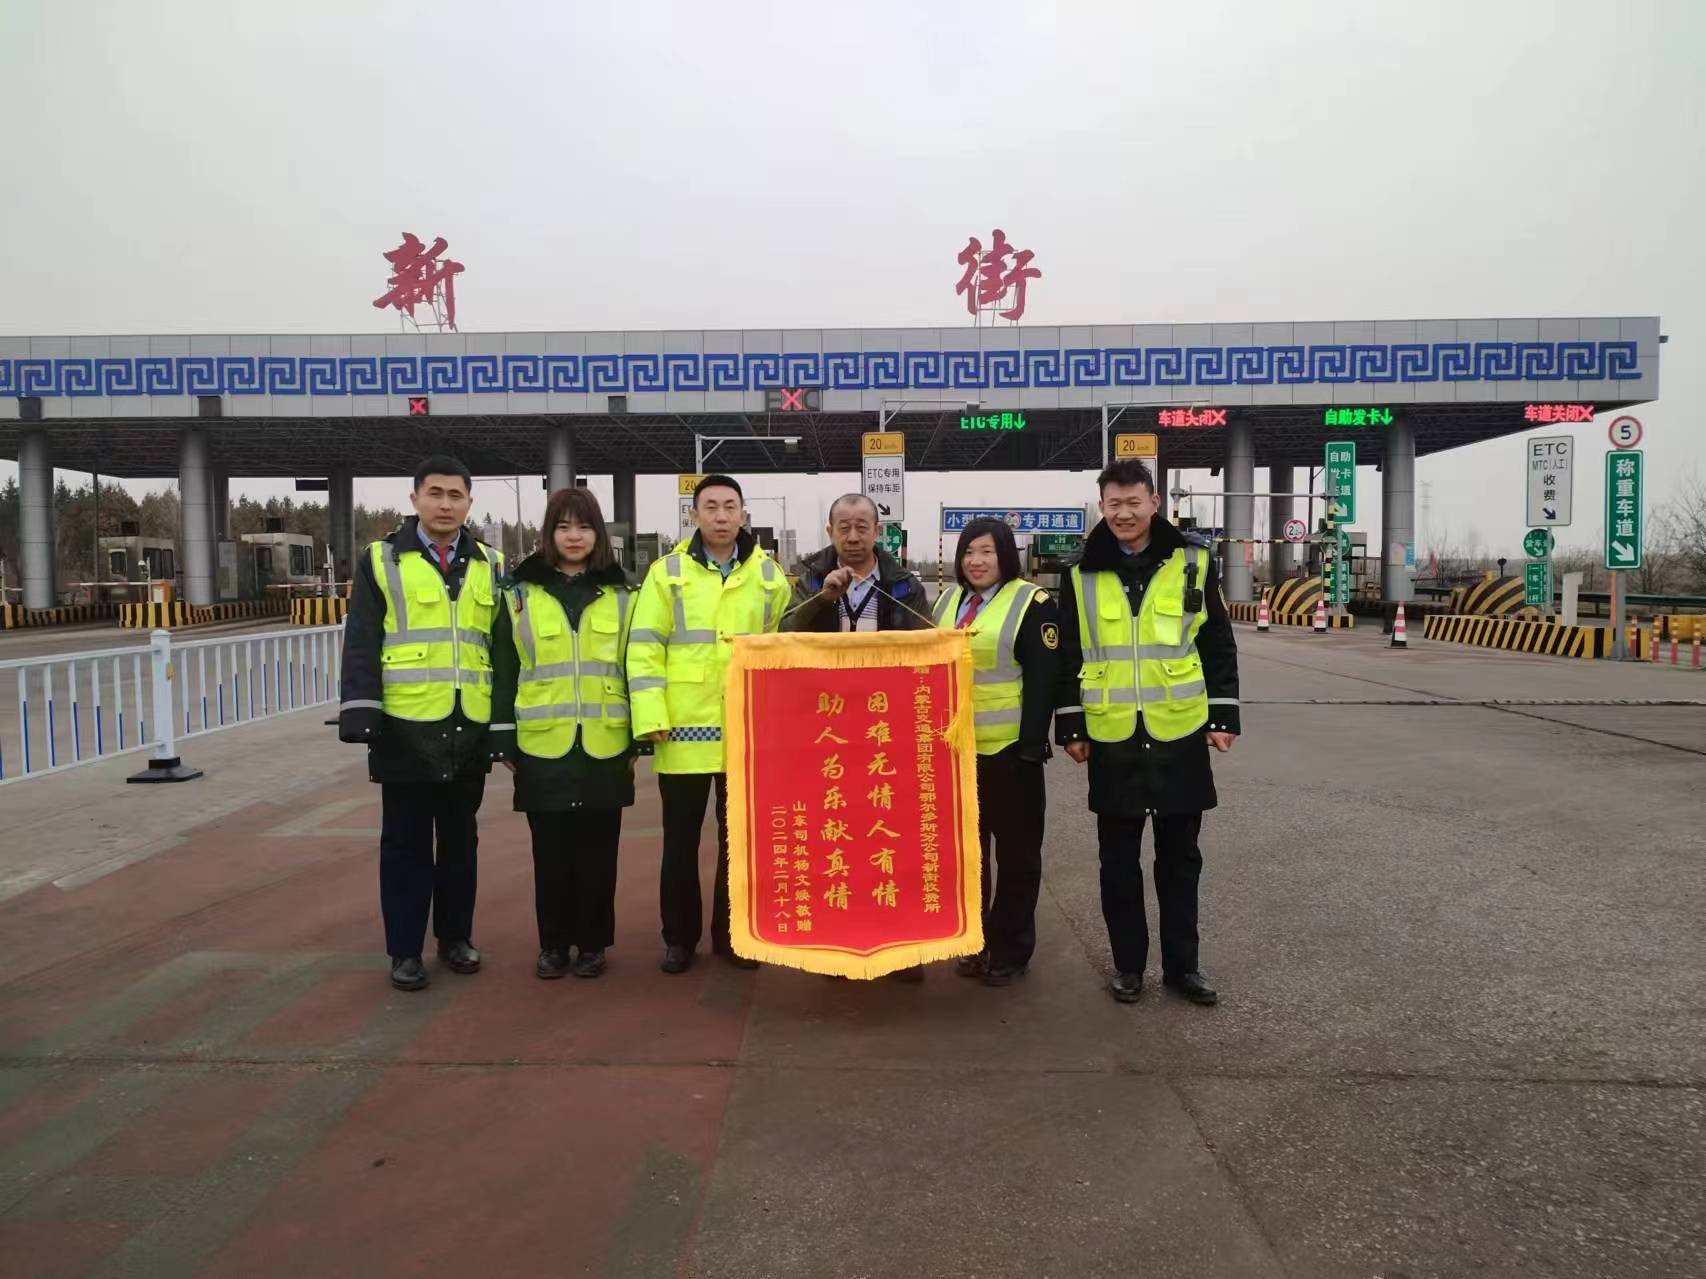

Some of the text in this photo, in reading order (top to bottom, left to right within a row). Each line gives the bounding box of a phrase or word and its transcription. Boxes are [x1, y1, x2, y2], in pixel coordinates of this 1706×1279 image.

[373, 229, 1042, 329] 新 街
[1158, 409, 1212, 427] 车道关闭
[1325, 408, 1380, 426] 自助发卡
[1524, 404, 1580, 422] 车道关闭
[1620, 425, 1632, 440] 5
[870, 438, 882, 450] 20
[1122, 439, 1135, 451] 20
[1533, 442, 1568, 456] ETC
[1330, 451, 1351, 463] 自助
[867, 468, 900, 479] ETC专用
[868, 483, 901, 493] 保持车距
[1543, 474, 1556, 501] 收费
[1615, 458, 1635, 537] 称重车道
[1023, 513, 1078, 528] 专用通道
[814, 692, 854, 910] 助人为乐献真情
[864, 691, 901, 908] 困难无情人有情
